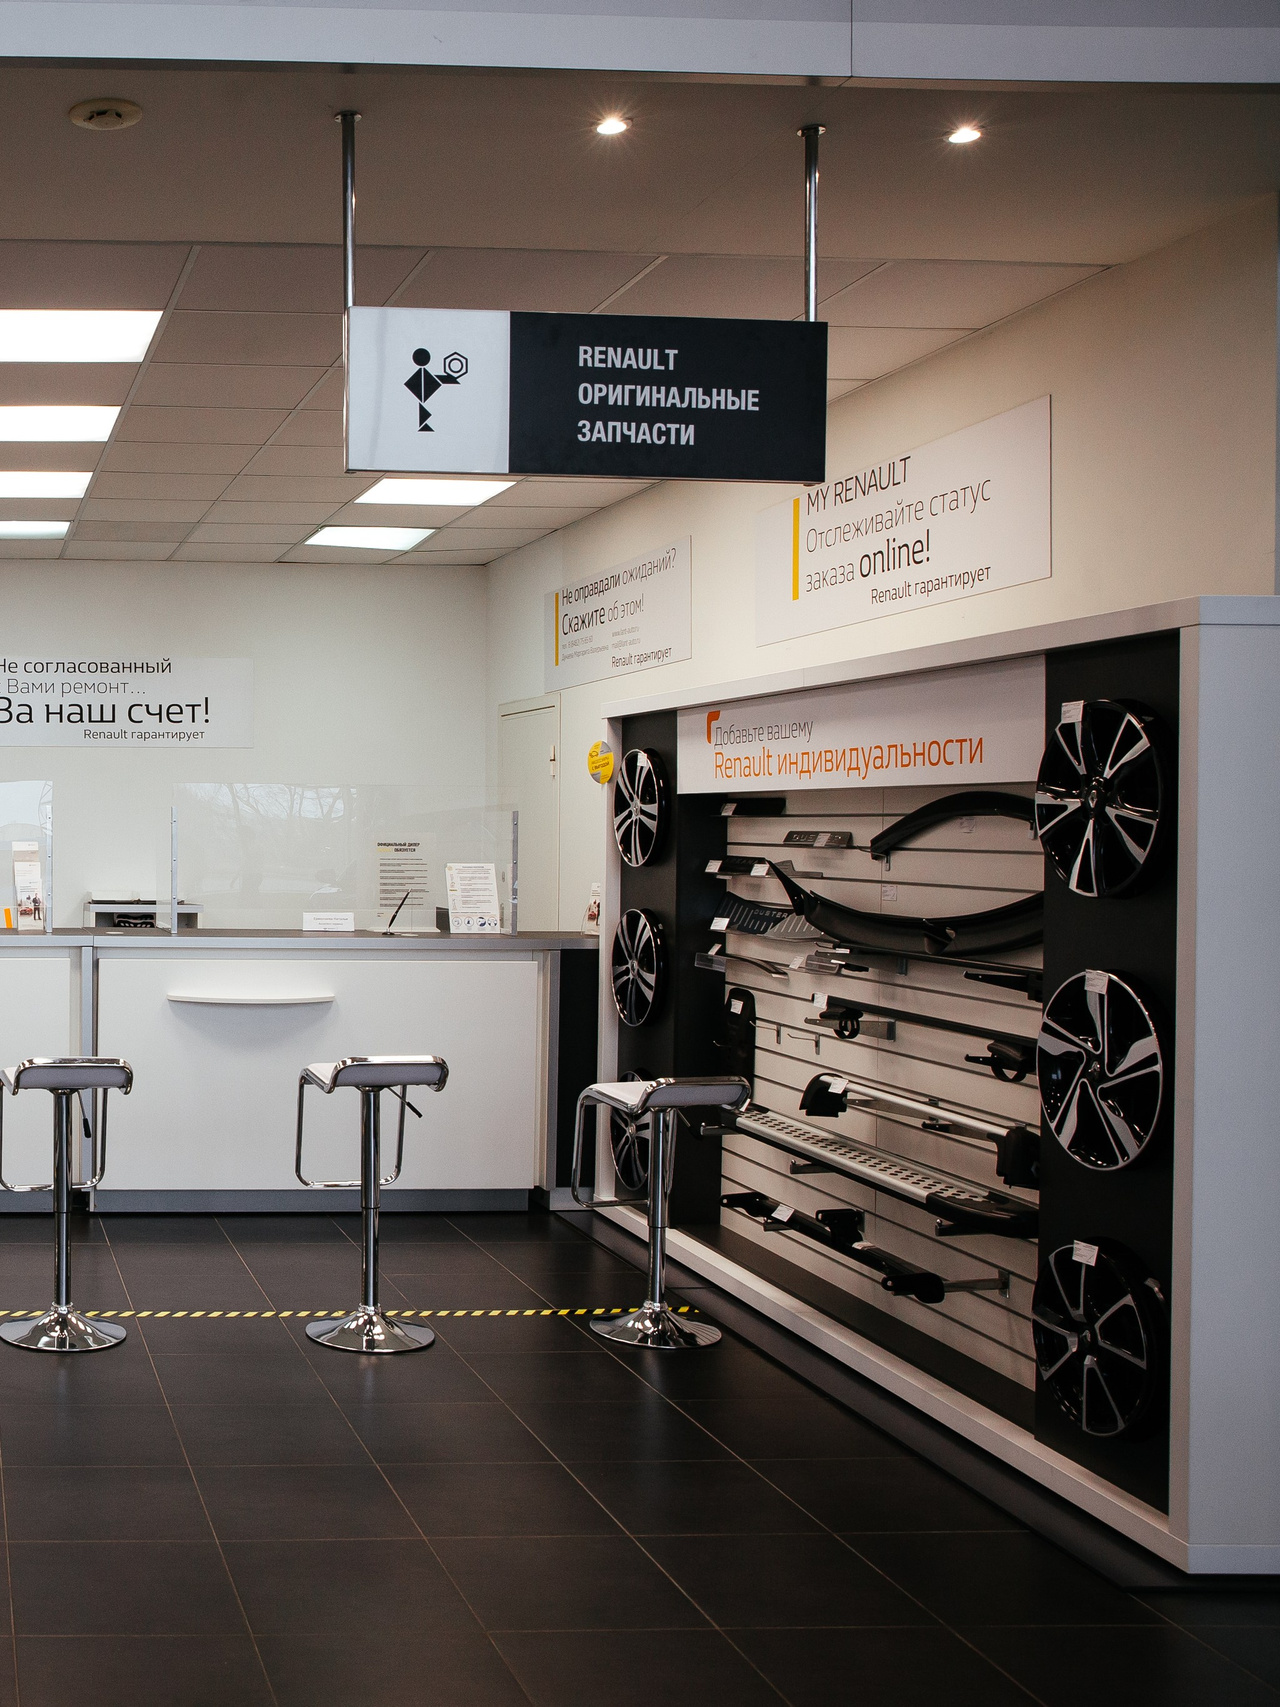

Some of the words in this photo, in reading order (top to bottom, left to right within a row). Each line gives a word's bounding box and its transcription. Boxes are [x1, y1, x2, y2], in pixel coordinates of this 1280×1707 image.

[578, 345, 678, 371] RENAULT
[578, 382, 760, 412] ОРИГИНАЛЬНЫЕ
[577, 419, 696, 446] ЗАПЧАСТИ
[806, 486, 830, 516] MY
[834, 455, 911, 508] RENAULT
[805, 499, 925, 554] Отслеживайте
[928, 479, 991, 517] статус
[805, 563, 856, 594] заказа
[859, 528, 932, 578] online!
[562, 588, 573, 606] Не
[574, 573, 621, 603] оправдали
[622, 547, 677, 585] ожиданий?
[870, 579, 912, 605] Renault
[914, 565, 992, 599] гарантирует
[562, 606, 606, 636] Скажите
[607, 600, 619, 622] об
[620, 592, 645, 619] этом!
[23, 657, 173, 674] согласованный
[611, 652, 633, 668] Renault
[633, 647, 673, 666] гарантирует
[7, 678, 55, 695] Вами
[60, 681, 147, 698] ремонт...
[44, 702, 117, 725] наш
[126, 696, 211, 725] счет!
[83, 728, 128, 740] Renault
[130, 730, 206, 743] гарантирует
[714, 721, 765, 749] Добавьте
[767, 719, 814, 744] вашему
[714, 746, 773, 780] Renault
[777, 736, 984, 781] индивидуальности
[753, 908, 789, 919] DUSTER
